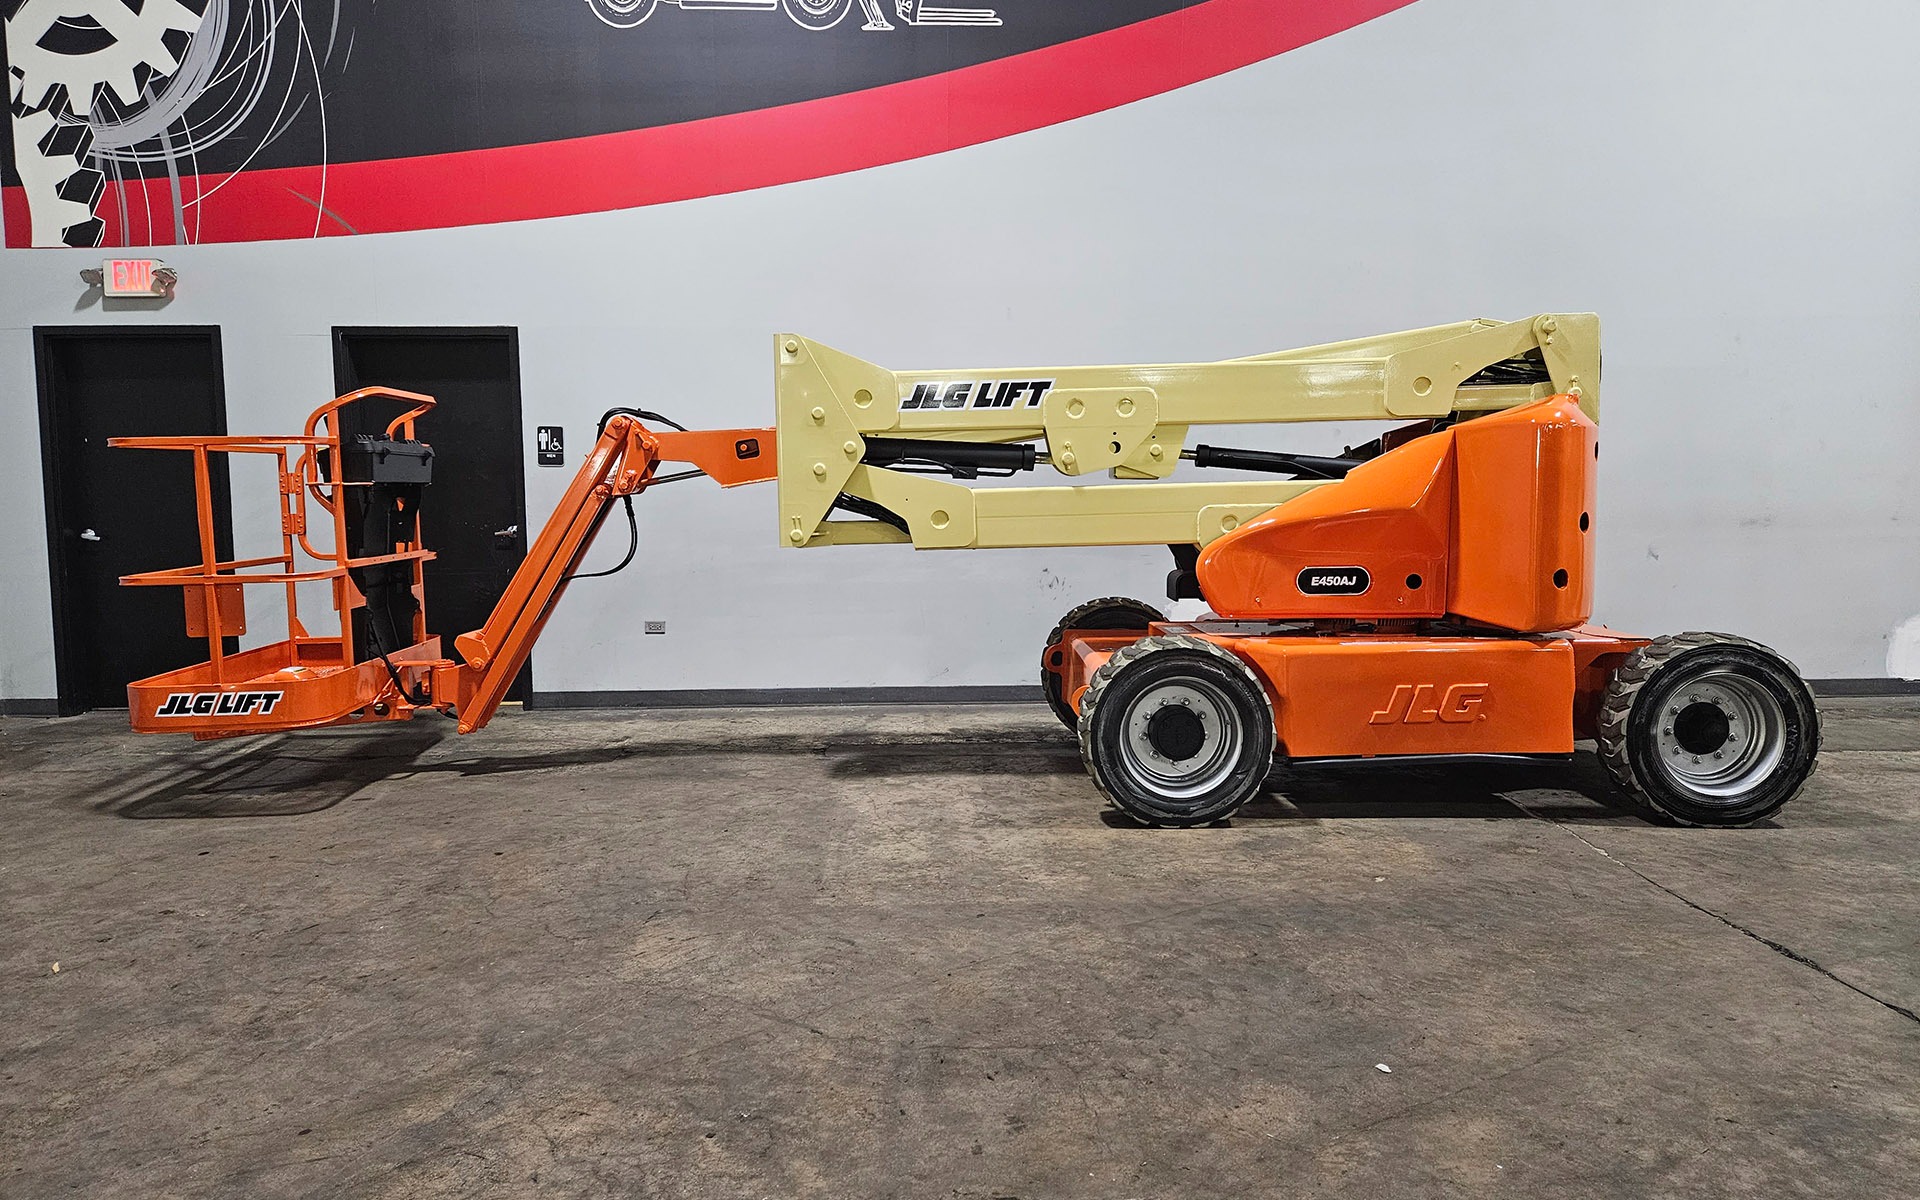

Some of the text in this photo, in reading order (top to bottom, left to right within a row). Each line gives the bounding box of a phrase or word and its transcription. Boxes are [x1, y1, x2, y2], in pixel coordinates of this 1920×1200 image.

[112, 260, 152, 291] EXIT
[901, 380, 1053, 410] JLG LIFT
[1311, 575, 1357, 587] E450AJ
[156, 692, 282, 716] JLG LIFT
